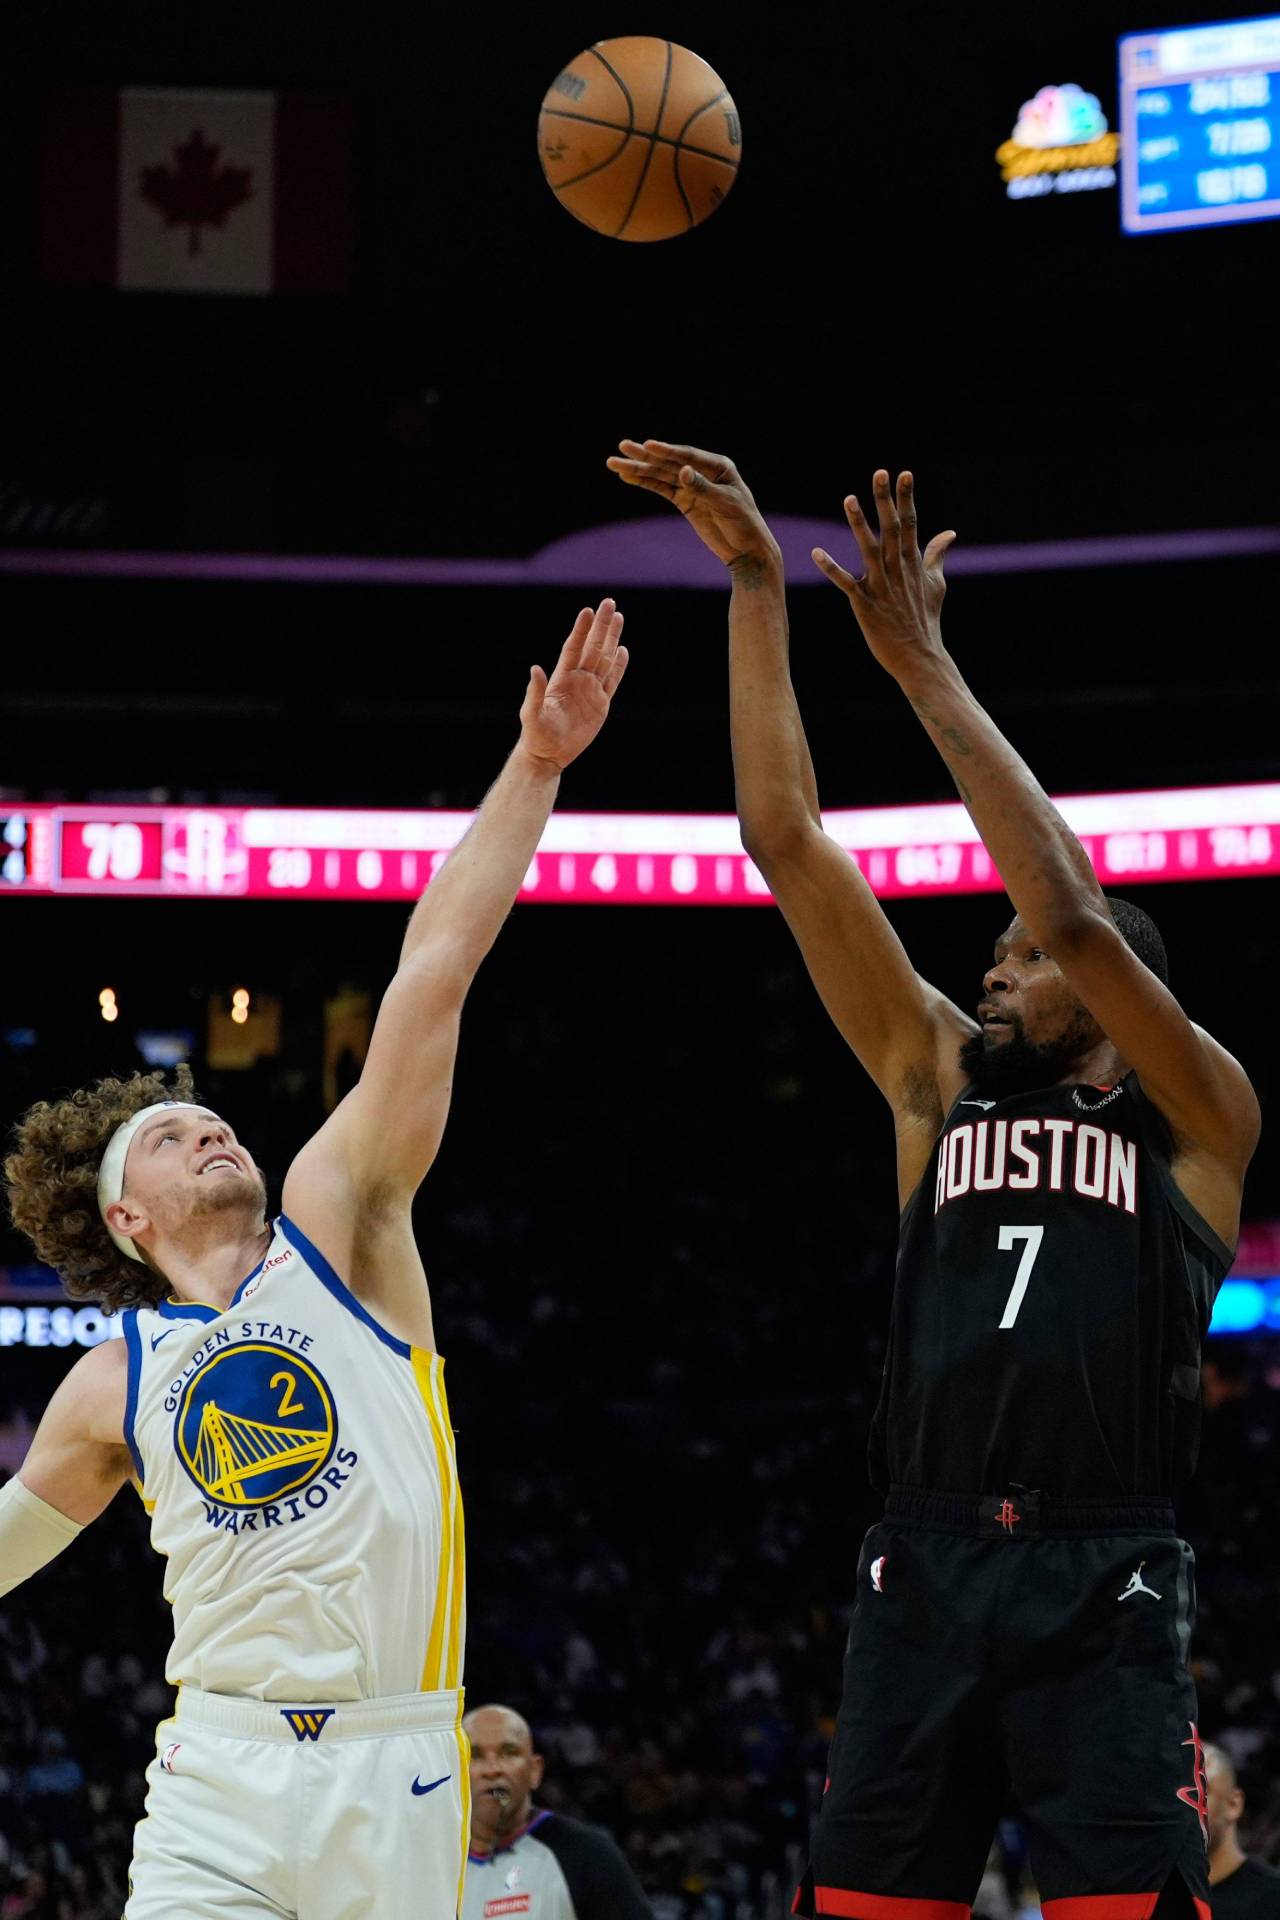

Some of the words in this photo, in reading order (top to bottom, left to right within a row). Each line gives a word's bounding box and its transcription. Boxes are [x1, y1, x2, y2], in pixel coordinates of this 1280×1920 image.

[933, 1117, 1138, 1217] HOUSTON
[997, 1225, 1044, 1329] 7
[164, 1328, 230, 1413] GOLDEN
[241, 1322, 315, 1352] STATE
[269, 1371, 305, 1418] 2
[200, 1447, 359, 1536] WARRIORS
